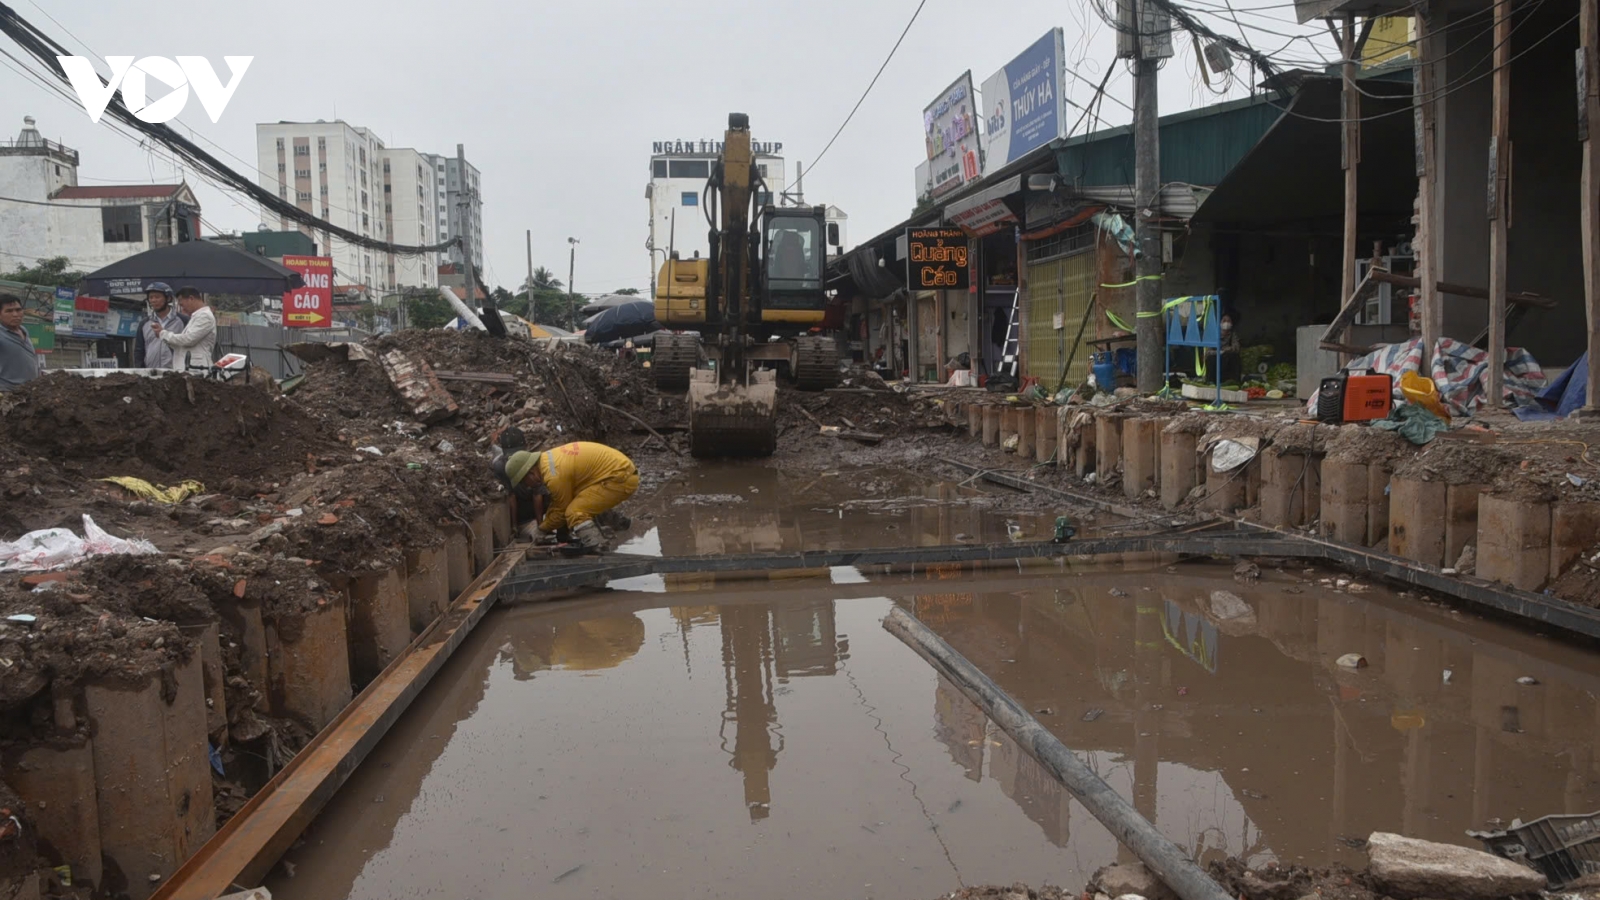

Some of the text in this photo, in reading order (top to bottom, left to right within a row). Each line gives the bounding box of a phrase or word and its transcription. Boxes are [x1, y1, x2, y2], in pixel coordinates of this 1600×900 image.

[1013, 72, 1053, 121] THÚY HÀ
[653, 138, 695, 154] NGÂN
[286, 258, 330, 267] HOÀNG THÀNH
[910, 238, 968, 268] Quảng
[302, 268, 329, 288] ẢNG
[921, 265, 957, 287] Cáo
[293, 291, 320, 310] CÁO
